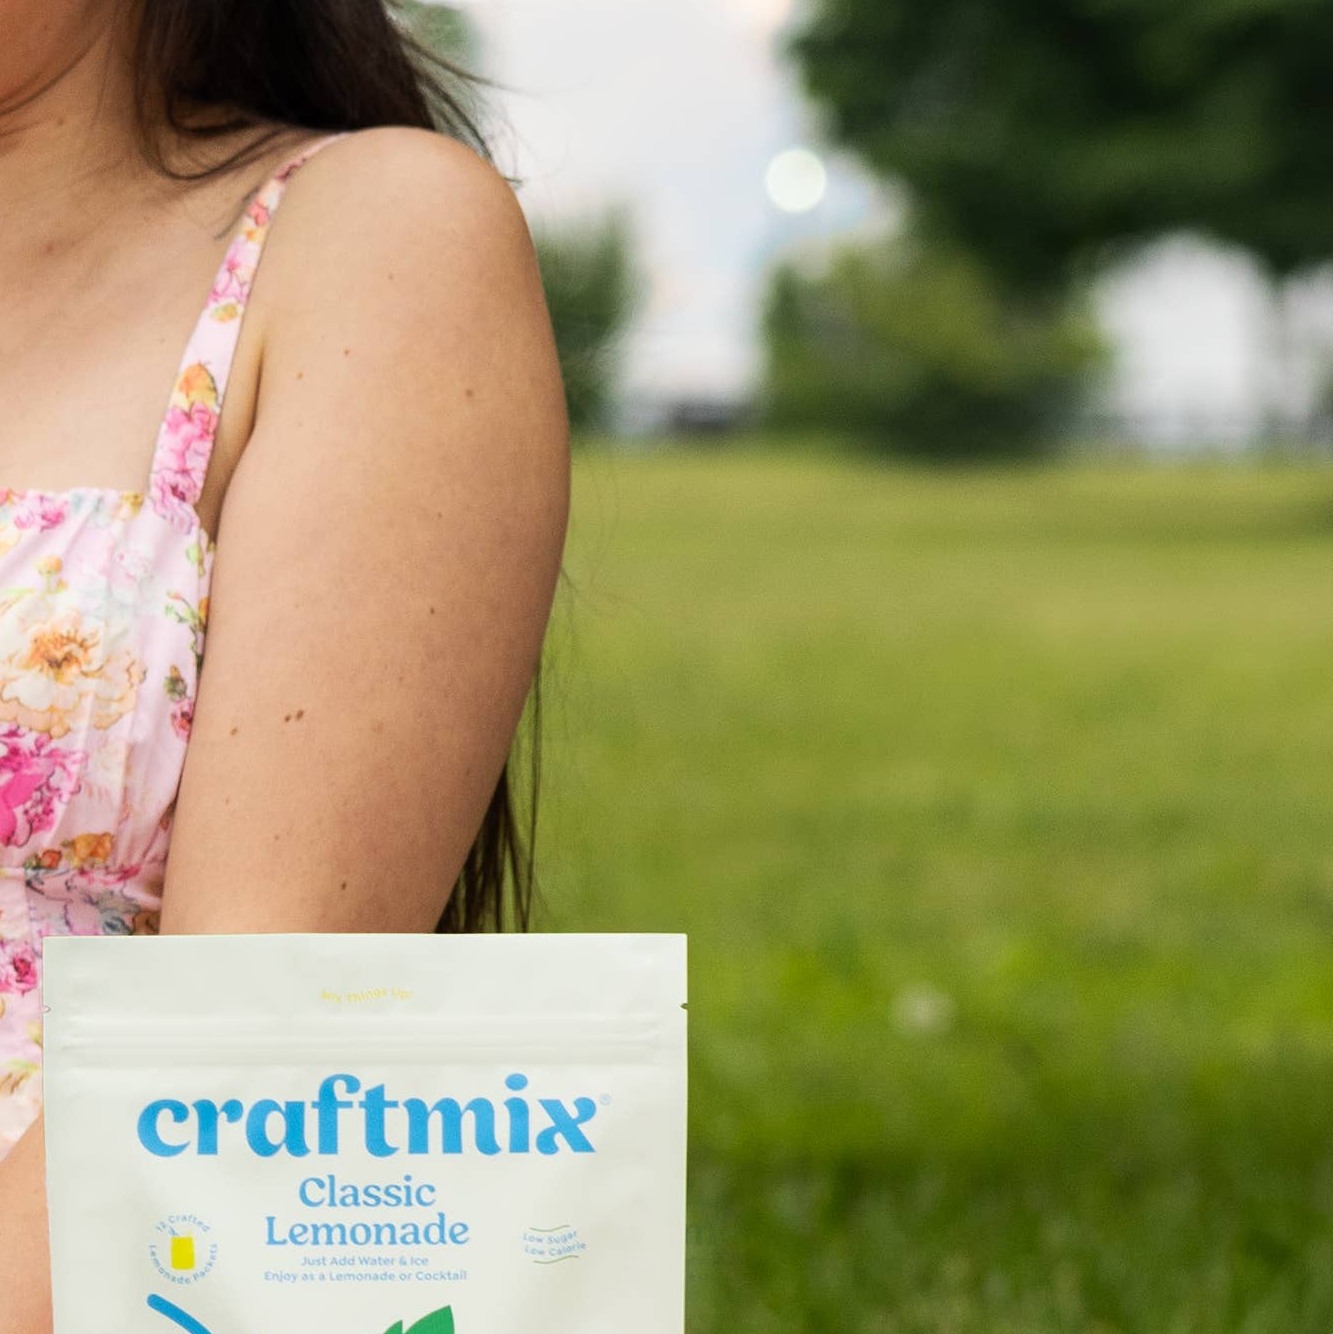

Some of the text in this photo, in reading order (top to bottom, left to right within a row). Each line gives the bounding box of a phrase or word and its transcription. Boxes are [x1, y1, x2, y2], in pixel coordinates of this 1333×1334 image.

[137, 1073, 598, 1157] craftmix
[299, 1174, 436, 1207] Classic
[168, 1214, 210, 1233] Crafted
[265, 1212, 470, 1246] Lemonade
[523, 1229, 578, 1245] Low Sugar
[524, 1242, 587, 1257] Low Calorie
[149, 1244, 191, 1284] Lemonade
[301, 1255, 429, 1267] Just Add Water & Ice
[264, 1270, 298, 1283] Enjoy
[301, 1273, 315, 1281] as
[329, 1270, 396, 1281] Lemonade
[399, 1273, 412, 1281] or
[415, 1269, 468, 1281] Cocktail
